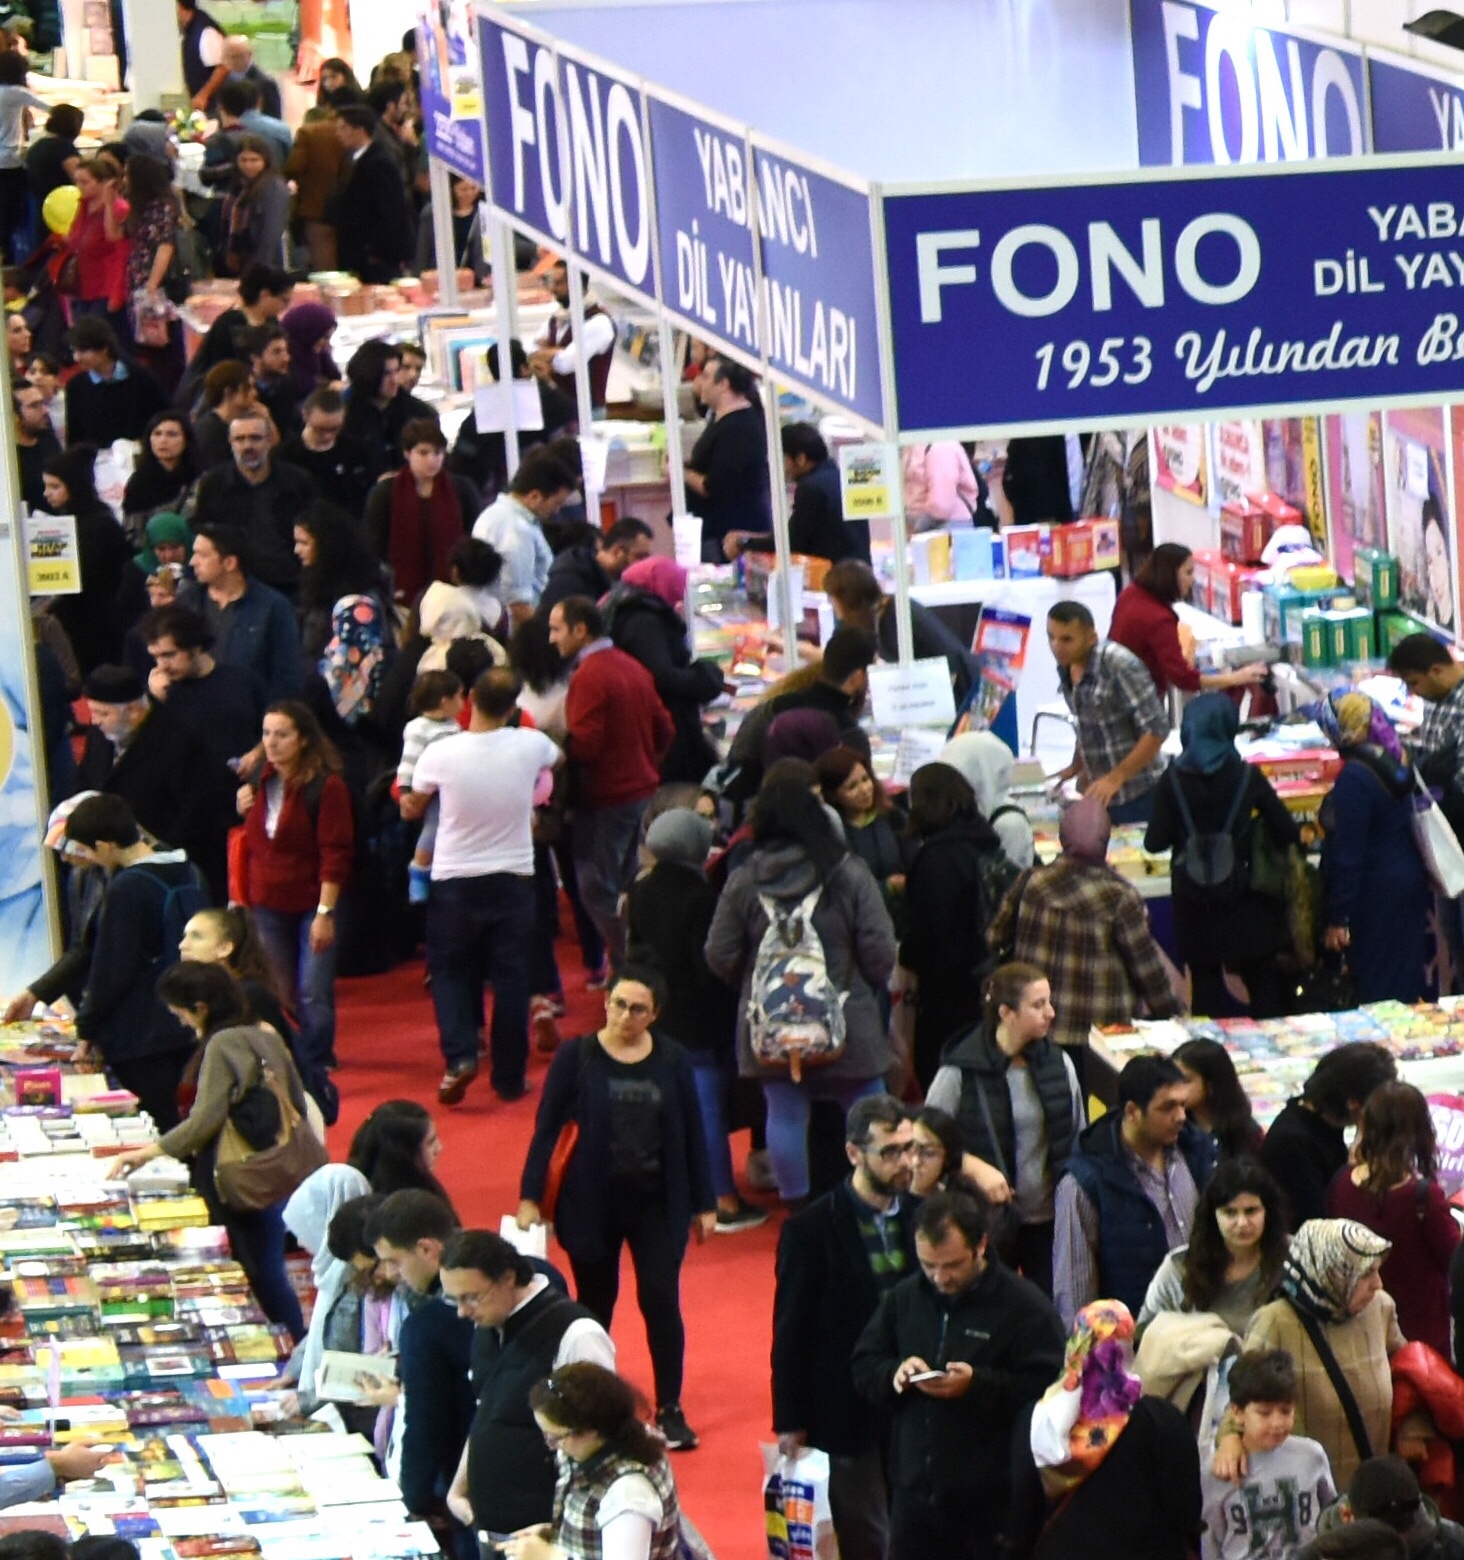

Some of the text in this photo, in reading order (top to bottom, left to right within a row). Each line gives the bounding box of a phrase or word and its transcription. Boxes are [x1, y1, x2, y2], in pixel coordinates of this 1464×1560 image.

[503, 32, 650, 287] FONO
[695, 127, 819, 257] YABANCI
[676, 218, 716, 316] DİL
[915, 212, 1262, 325] FONO
[1313, 248, 1384, 297] DİL
[716, 250, 858, 399] YAYINLARI
[1034, 337, 1153, 393] 1953
[1175, 322, 1400, 393] Yılından
